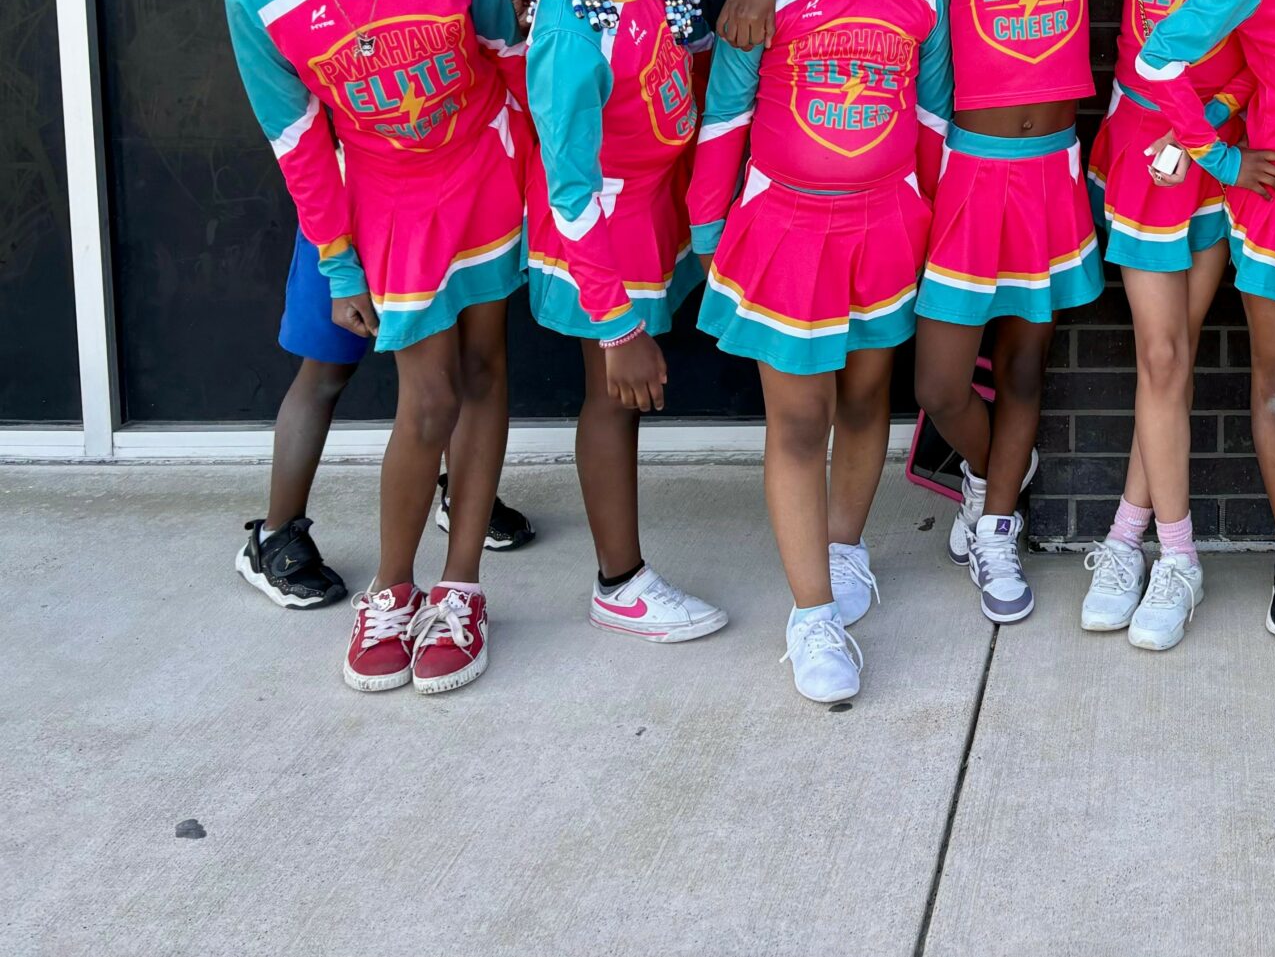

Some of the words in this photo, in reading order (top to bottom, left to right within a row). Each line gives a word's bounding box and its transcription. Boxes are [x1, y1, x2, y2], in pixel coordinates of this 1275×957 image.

[310, 18, 335, 31] HYPE
[802, 10, 823, 19] HYPE
[993, 9, 1069, 41] CHEER
[791, 27, 914, 66] PWRHAUS
[343, 51, 461, 114] ELITE
[803, 58, 900, 91] ELITE
[807, 98, 893, 130] CHEER
